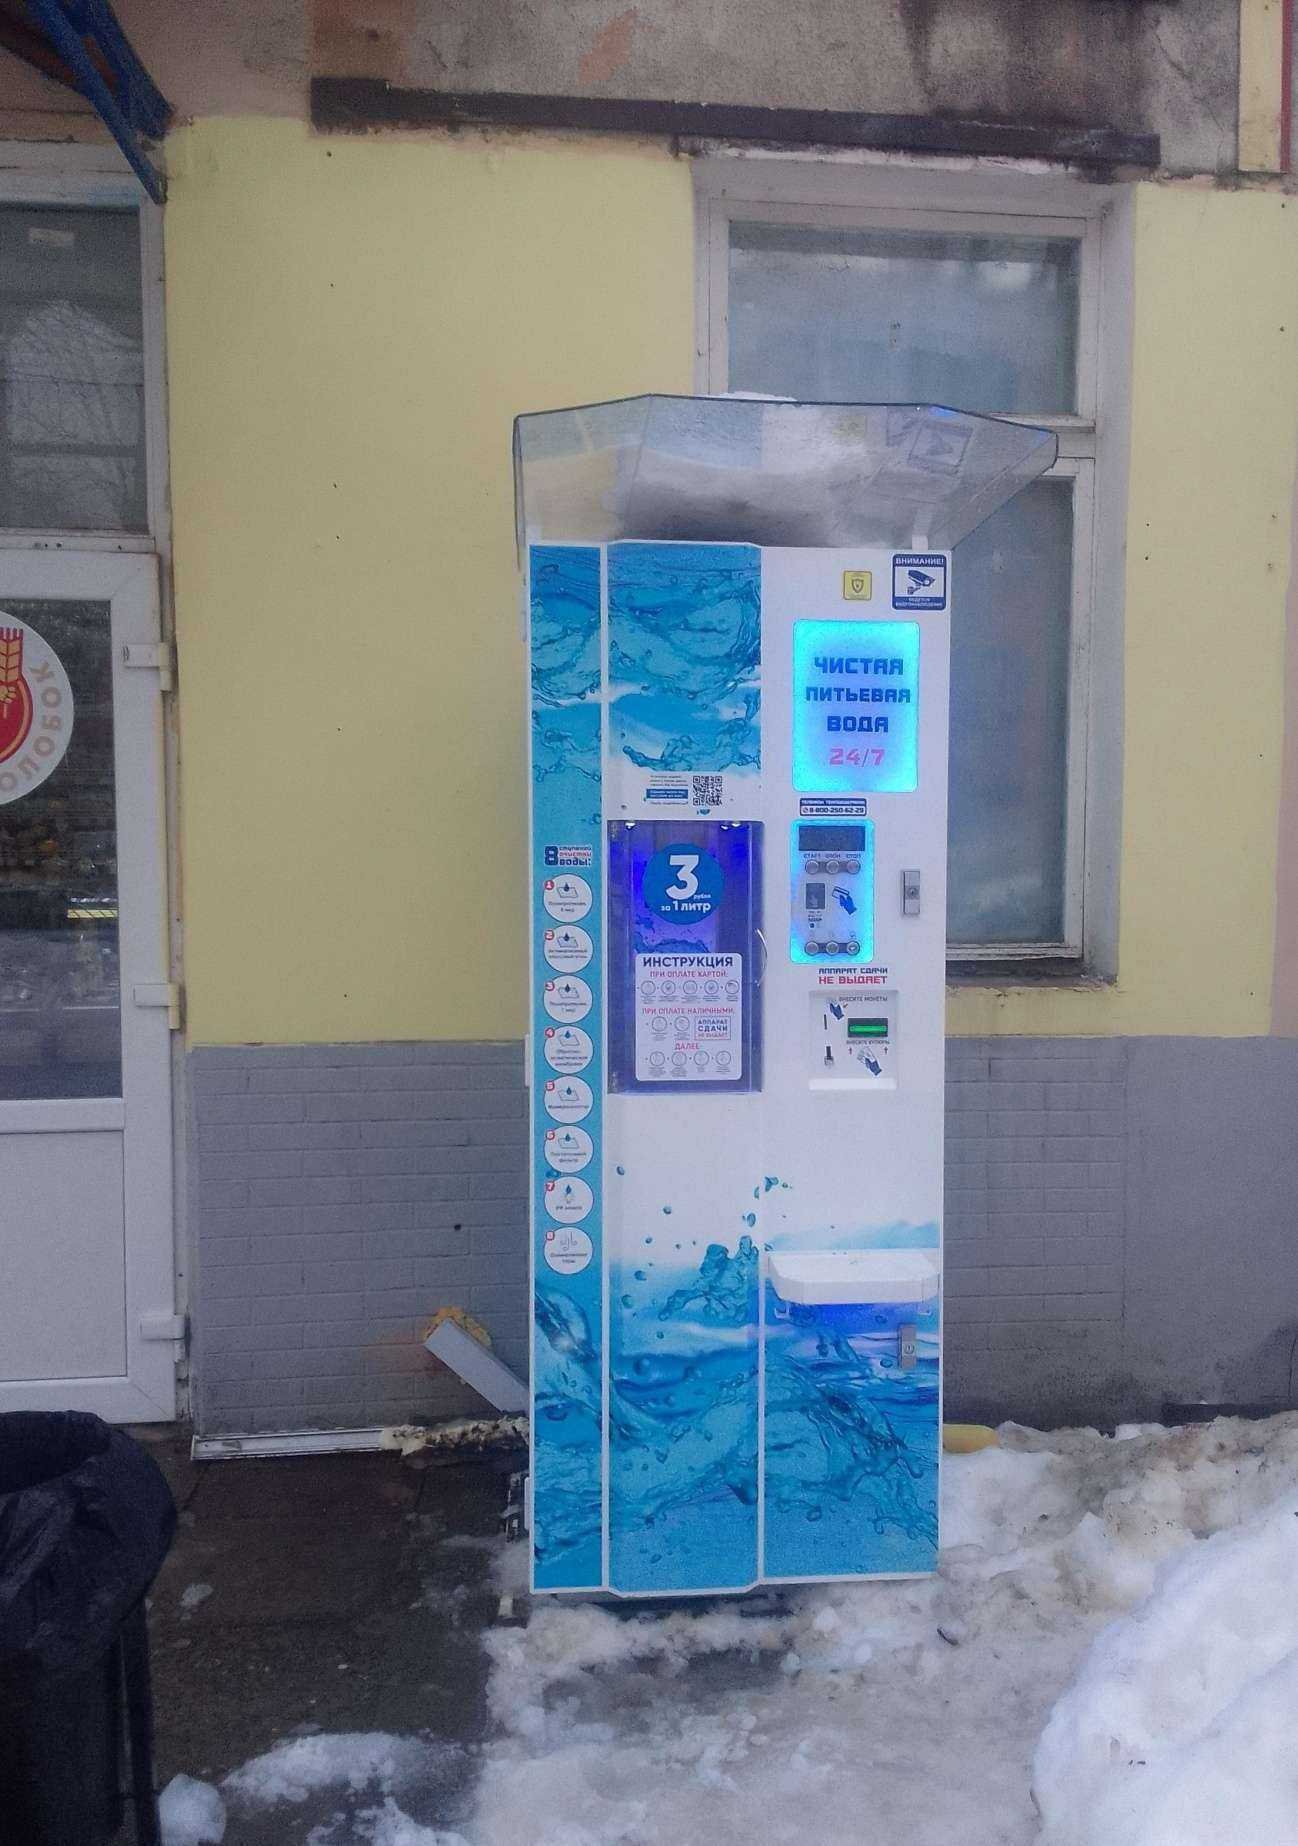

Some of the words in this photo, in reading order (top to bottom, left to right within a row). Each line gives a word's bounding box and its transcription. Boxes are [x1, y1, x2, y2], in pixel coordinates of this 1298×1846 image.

[895, 557, 945, 565] ВНИМАНИЕ!
[814, 656, 904, 675] ЧИСТАЯ
[805, 687, 911, 703] ПИТЬЕВАЯ
[0, 661, 62, 792] ОЛОБОК
[826, 715, 889, 733] ВОДА
[828, 748, 885, 767] 24/7
[545, 846, 559, 866] 8
[666, 854, 700, 900] 3
[672, 901, 679, 911] 1
[681, 902, 711, 913] литр
[643, 957, 733, 968] ИНСТРУКЦИЯ
[818, 976, 834, 984] НЕ
[839, 976, 888, 984] ВЫДАЕТ
